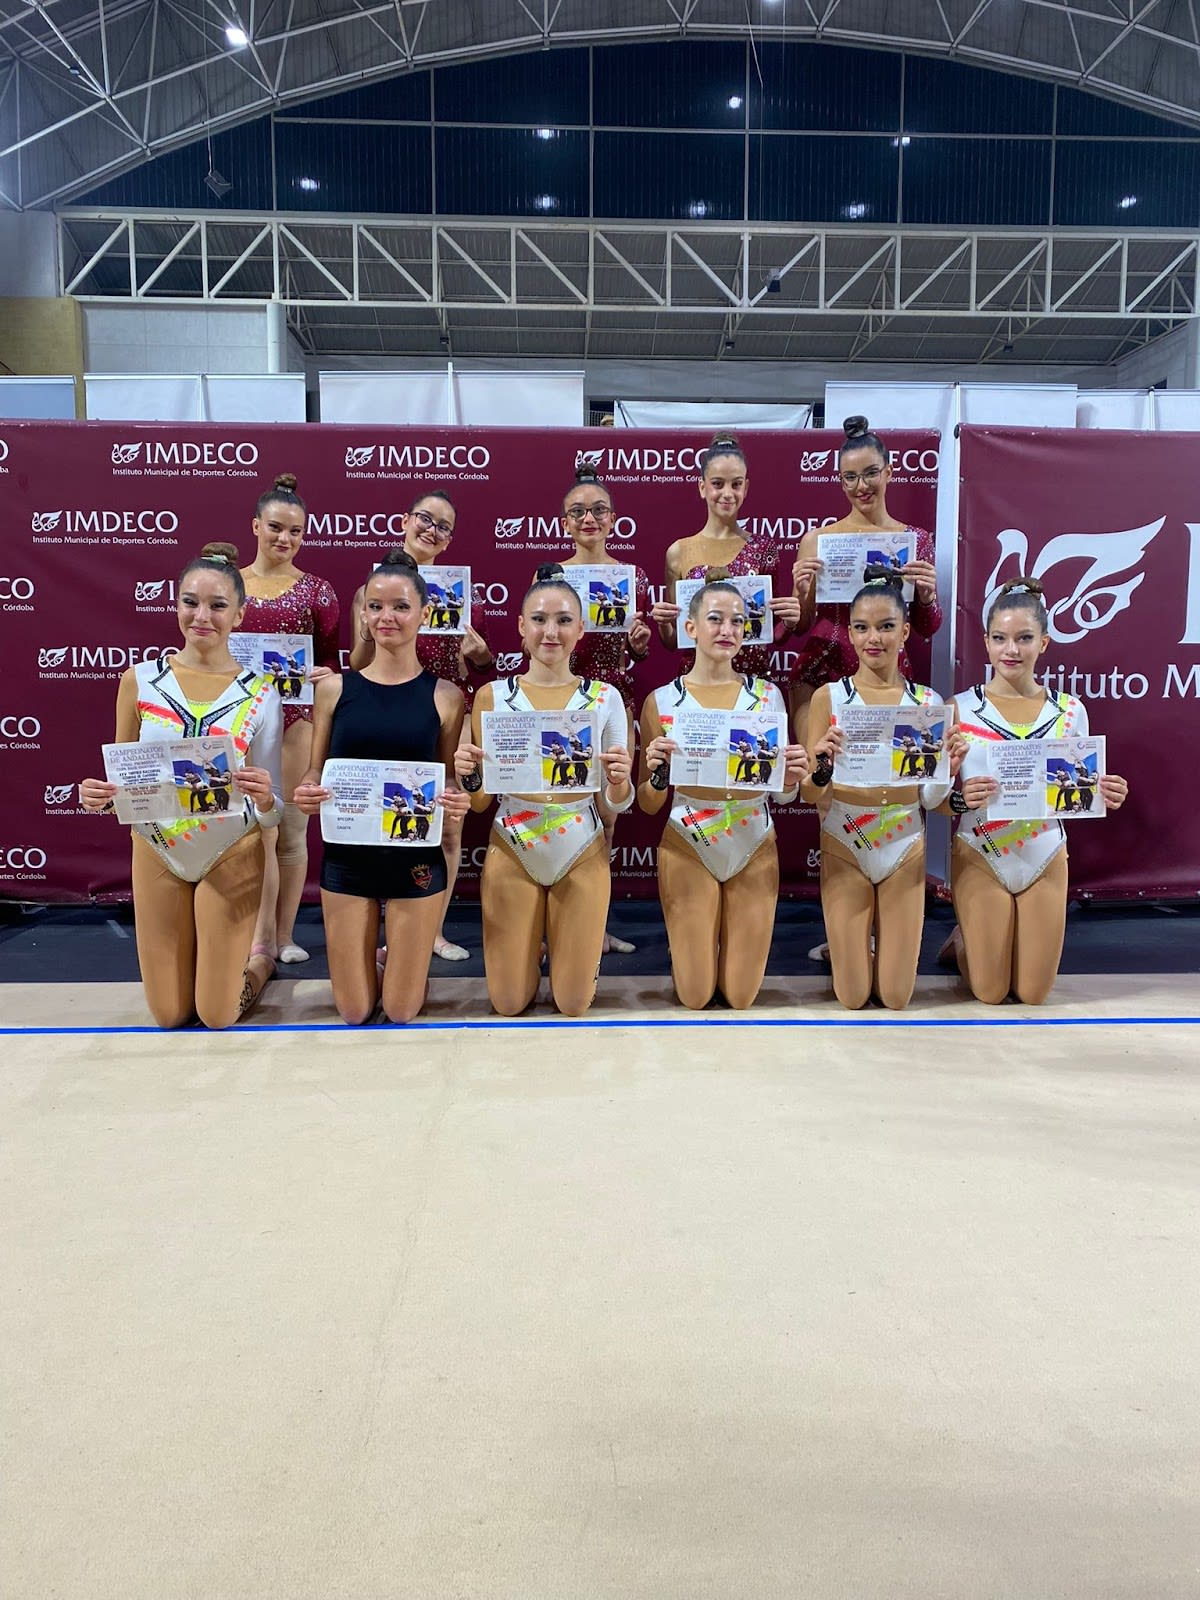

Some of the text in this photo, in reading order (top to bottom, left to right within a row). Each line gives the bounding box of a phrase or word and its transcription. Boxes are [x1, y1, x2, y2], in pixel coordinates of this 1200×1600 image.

[146, 442, 258, 465] IMDECO
[379, 446, 490, 469] IMDECO
[834, 449, 939, 471] IECO
[112, 467, 258, 478] Instituto Municipal de Deportes Córdoba
[346, 471, 490, 482] Instituto Municipal de Deportes Córdoba
[605, 474, 640, 484] Municipal
[652, 475, 684, 484] Deportes
[800, 475, 829, 483] Instituto
[65, 511, 178, 533] IMDECO
[306, 513, 406, 536] MDECO
[32, 536, 178, 546] Instituto Municipal de Deportes Córdoba
[344, 540, 376, 549] Deportes
[496, 542, 524, 550] Instituto
[526, 542, 560, 551] Municipal
[561, 542, 570, 550] de
[2, 603, 34, 611] Córdoba
[136, 604, 165, 612] Instituto
[39, 671, 69, 680] Instituto
[70, 671, 105, 681] Municipal
[106, 671, 116, 680] de
[10, 742, 40, 750] Córdoba
[778, 807, 788, 815] de
